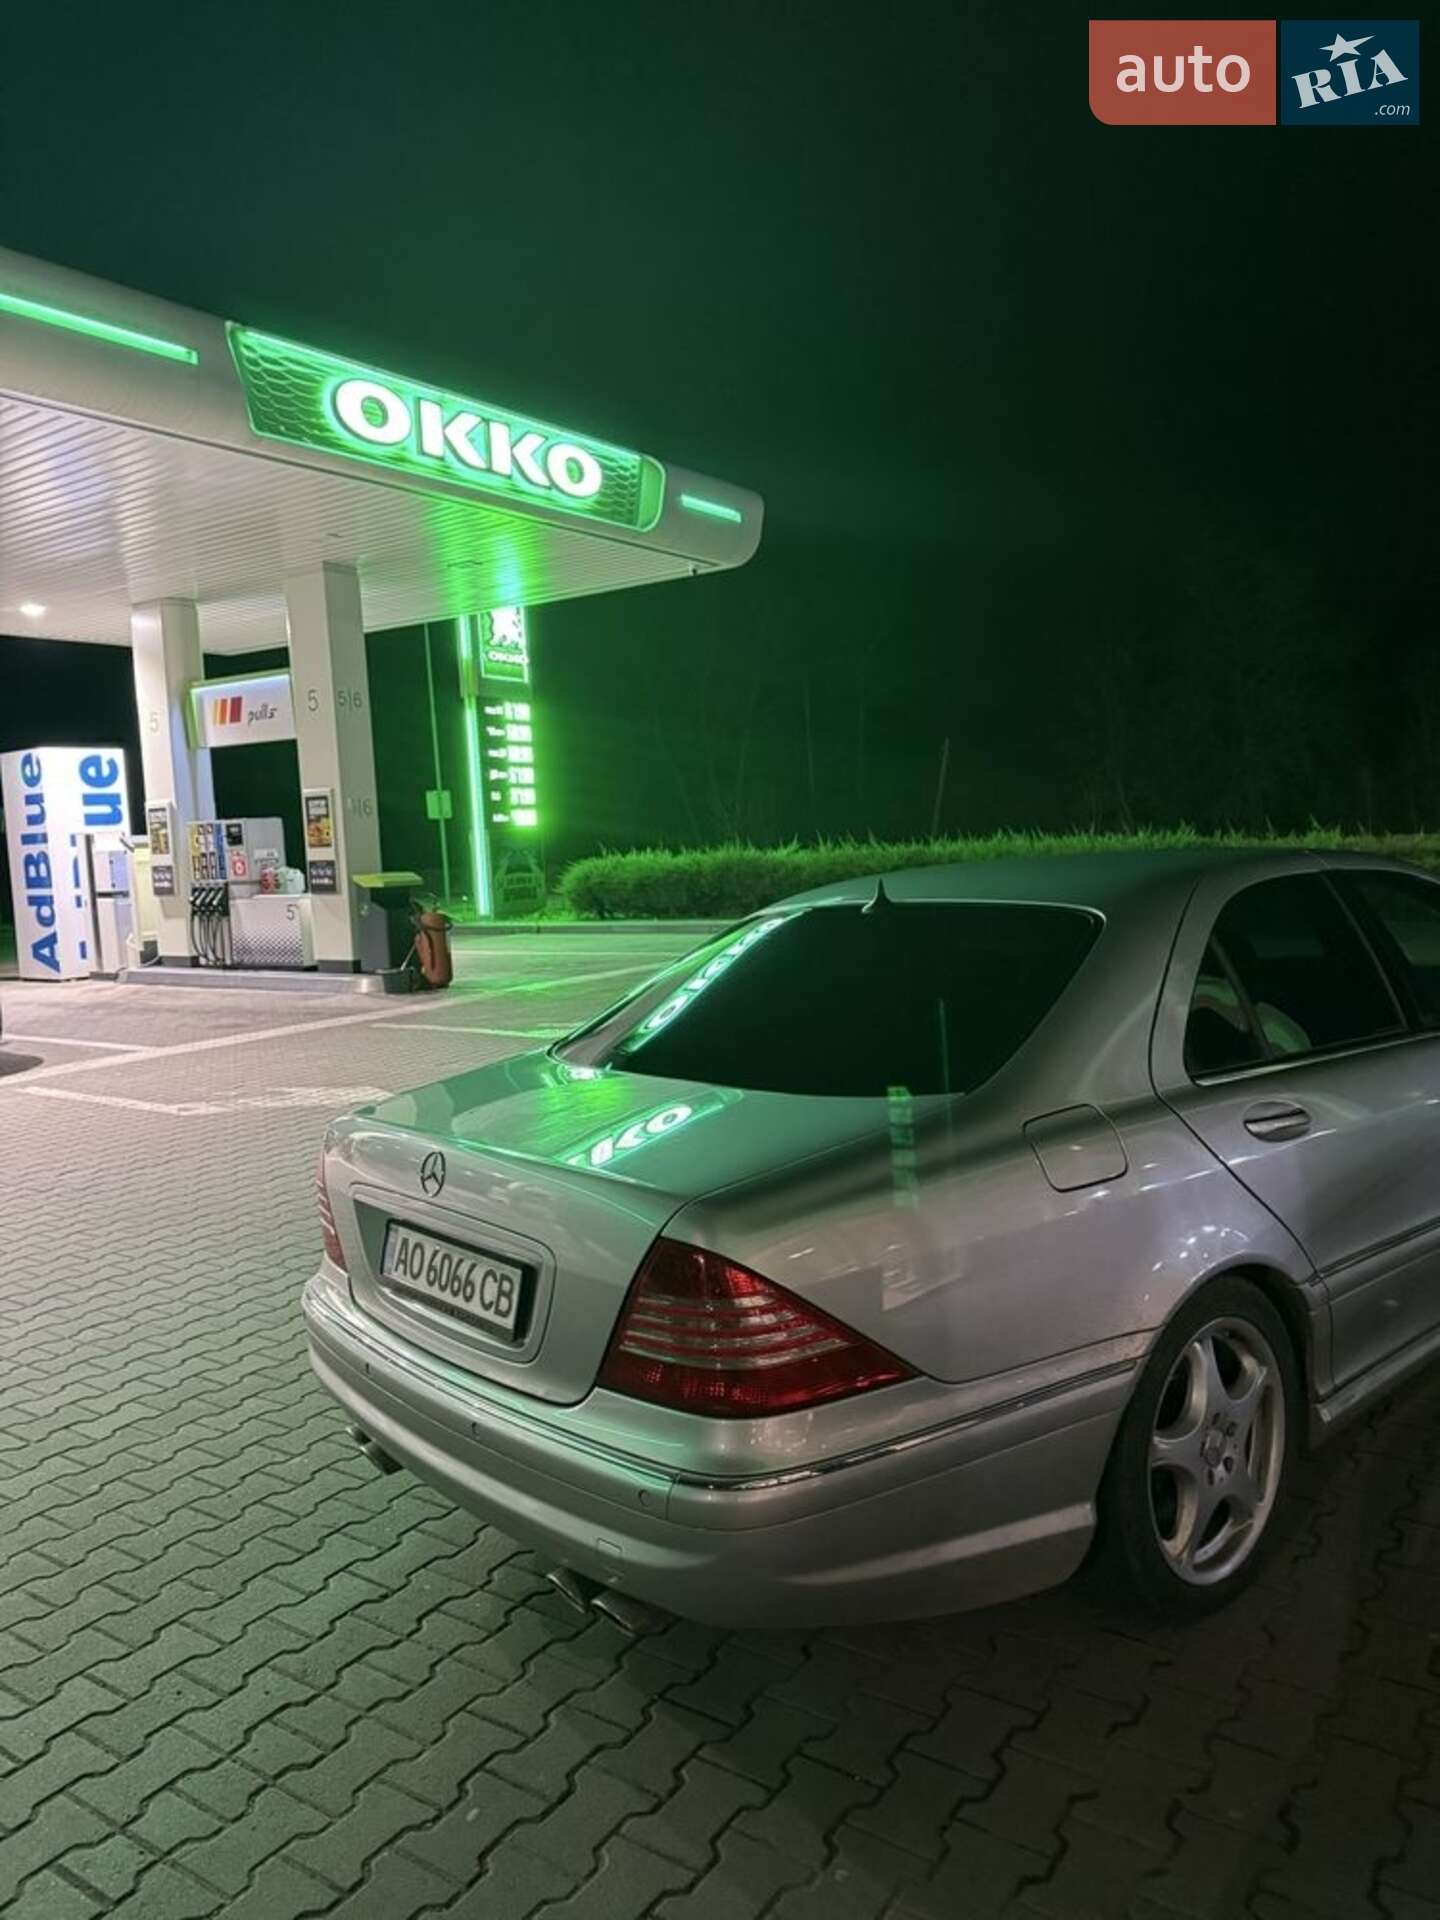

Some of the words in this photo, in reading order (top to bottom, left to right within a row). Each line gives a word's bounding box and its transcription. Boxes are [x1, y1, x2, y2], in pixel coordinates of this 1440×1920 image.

[334, 378, 603, 498] OKKO
[307, 689, 320, 712] 5
[20, 752, 61, 973] AdBlue
[286, 904, 298, 921] 5
[395, 1237, 425, 1280] AO
[426, 1249, 479, 1303] 6066
[480, 1268, 514, 1318] CB
